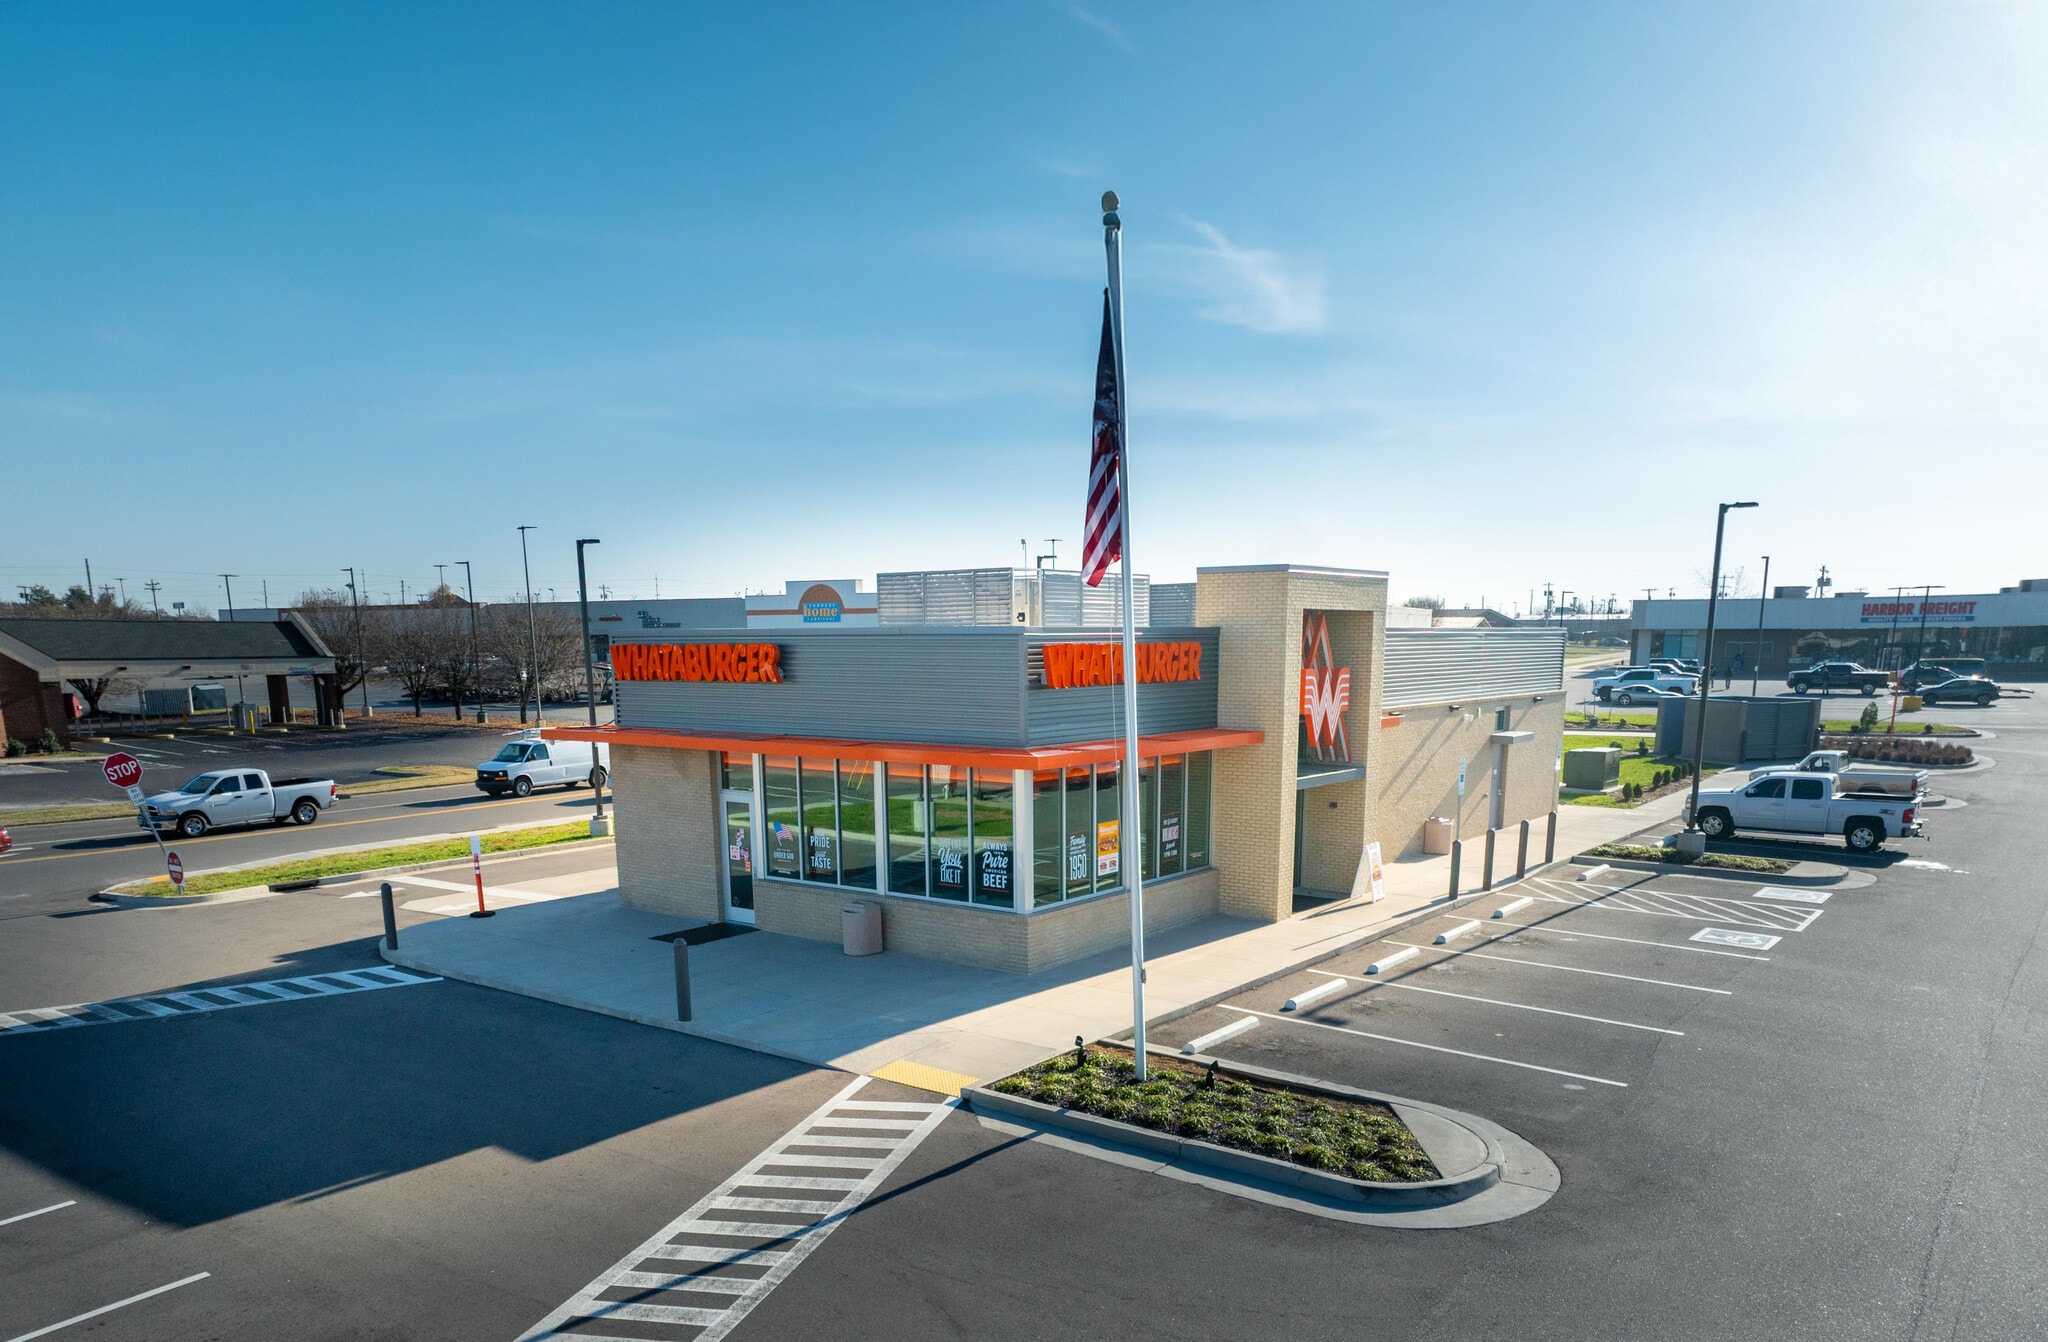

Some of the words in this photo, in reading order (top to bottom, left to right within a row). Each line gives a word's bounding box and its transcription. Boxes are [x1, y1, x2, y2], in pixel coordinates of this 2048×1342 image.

[804, 604, 837, 616] home
[1862, 603, 1914, 616] HARBOR
[1919, 602, 1977, 615] FREIGHT
[610, 643, 782, 684] WHATABURGER
[107, 760, 137, 780] STOP
[810, 835, 830, 848] PRIDE
[983, 842, 1008, 851] ALWAYS
[810, 856, 831, 869] TASTE
[938, 847, 963, 870] You
[983, 851, 1008, 869] Pure
[1069, 853, 1087, 881] 1950
[940, 868, 953, 883] LIKE
[955, 869, 961, 884] IT
[983, 873, 1007, 888] BEEF
